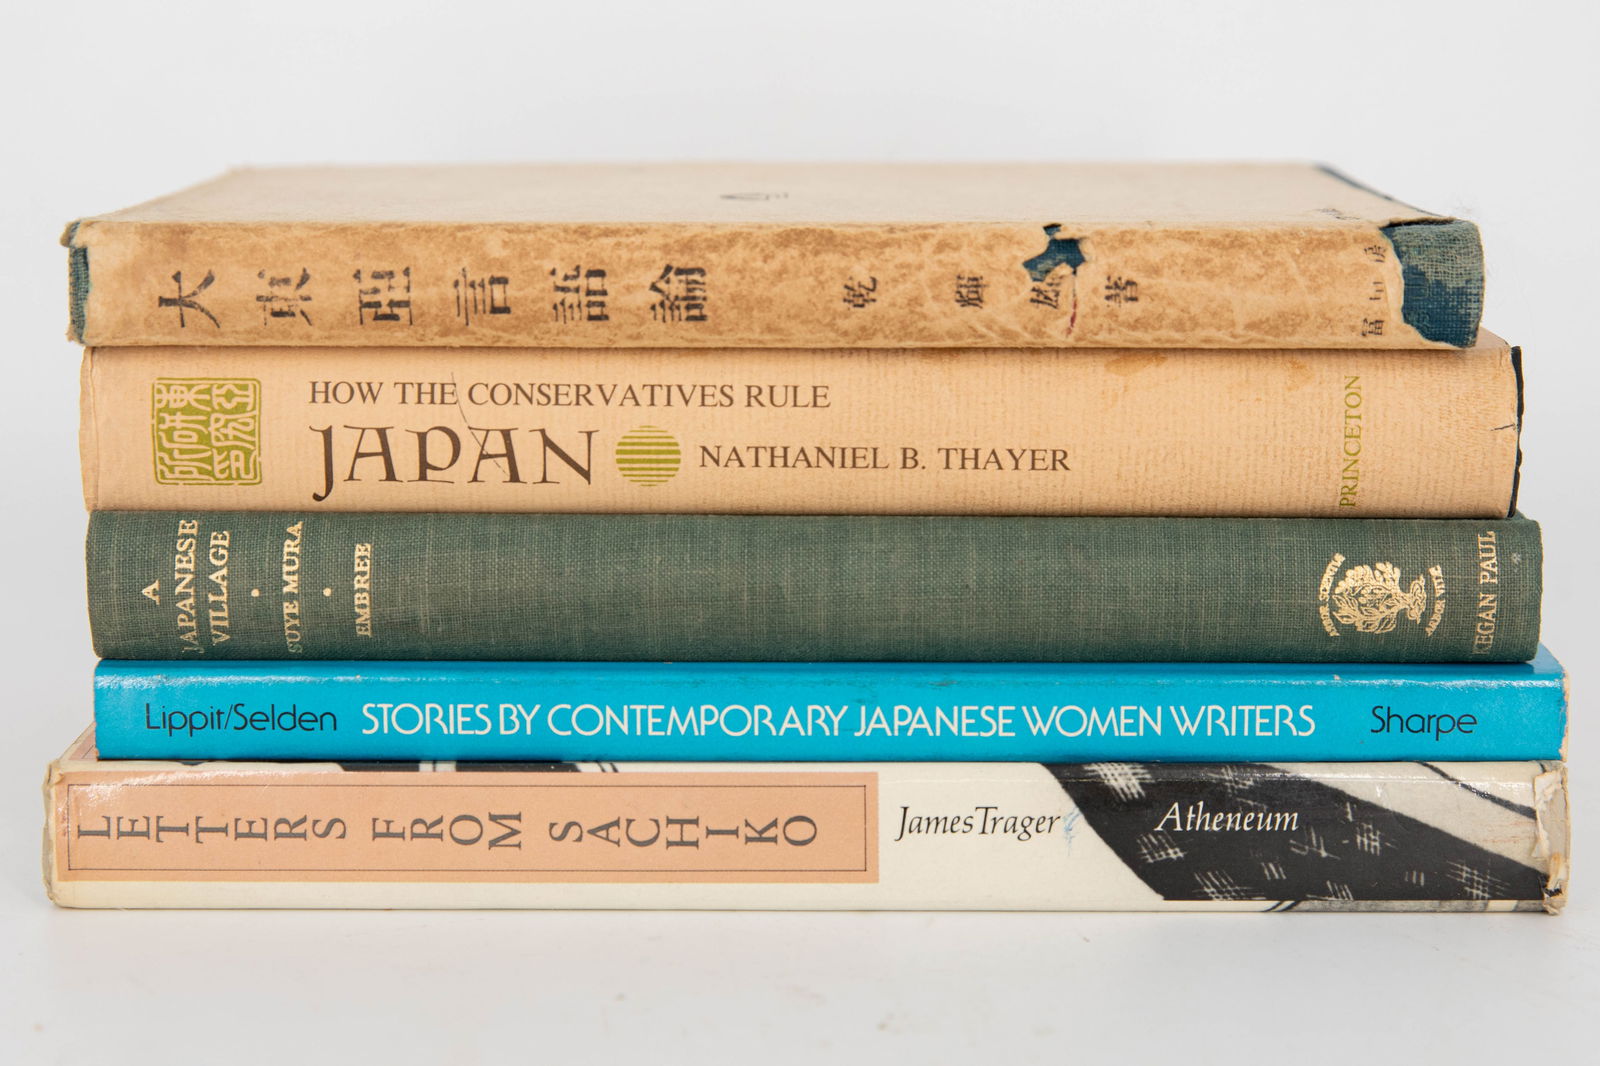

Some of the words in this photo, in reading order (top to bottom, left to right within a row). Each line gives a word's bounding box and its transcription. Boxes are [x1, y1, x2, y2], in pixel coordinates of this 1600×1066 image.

[310, 381, 383, 405] HOW
[393, 382, 458, 405] THE
[468, 383, 733, 408] CONSERVATIVES
[746, 385, 830, 408] RULE
[309, 424, 598, 502] JAPAN
[700, 446, 889, 469] NATHANIEL
[901, 448, 925, 469] B.
[938, 448, 1070, 471] THAYER
[1339, 375, 1362, 507] PRINCETON
[282, 521, 304, 594] MURA
[1477, 530, 1498, 585] PAUL
[141, 579, 161, 605] A
[174, 519, 203, 655] JAPANESE
[208, 530, 231, 646] VILLAGE
[353, 543, 372, 638] EMBREE
[282, 601, 304, 654] SUYE
[1472, 592, 1498, 655] KEGAN
[147, 704, 336, 737] Lippit/Selden
[362, 703, 492, 736] STORIES
[499, 704, 540, 736] BY
[548, 703, 848, 737] CONTEMPORARY
[853, 705, 1016, 738] JAPANESE
[1022, 705, 1162, 737] WOMEN
[1169, 704, 1316, 737] WRITERS
[1370, 706, 1477, 741] Sharpe
[77, 814, 347, 845] LETTERS
[372, 811, 522, 851] FROM
[549, 814, 818, 850] SACHIKO
[1155, 801, 1299, 833] Atheneum
